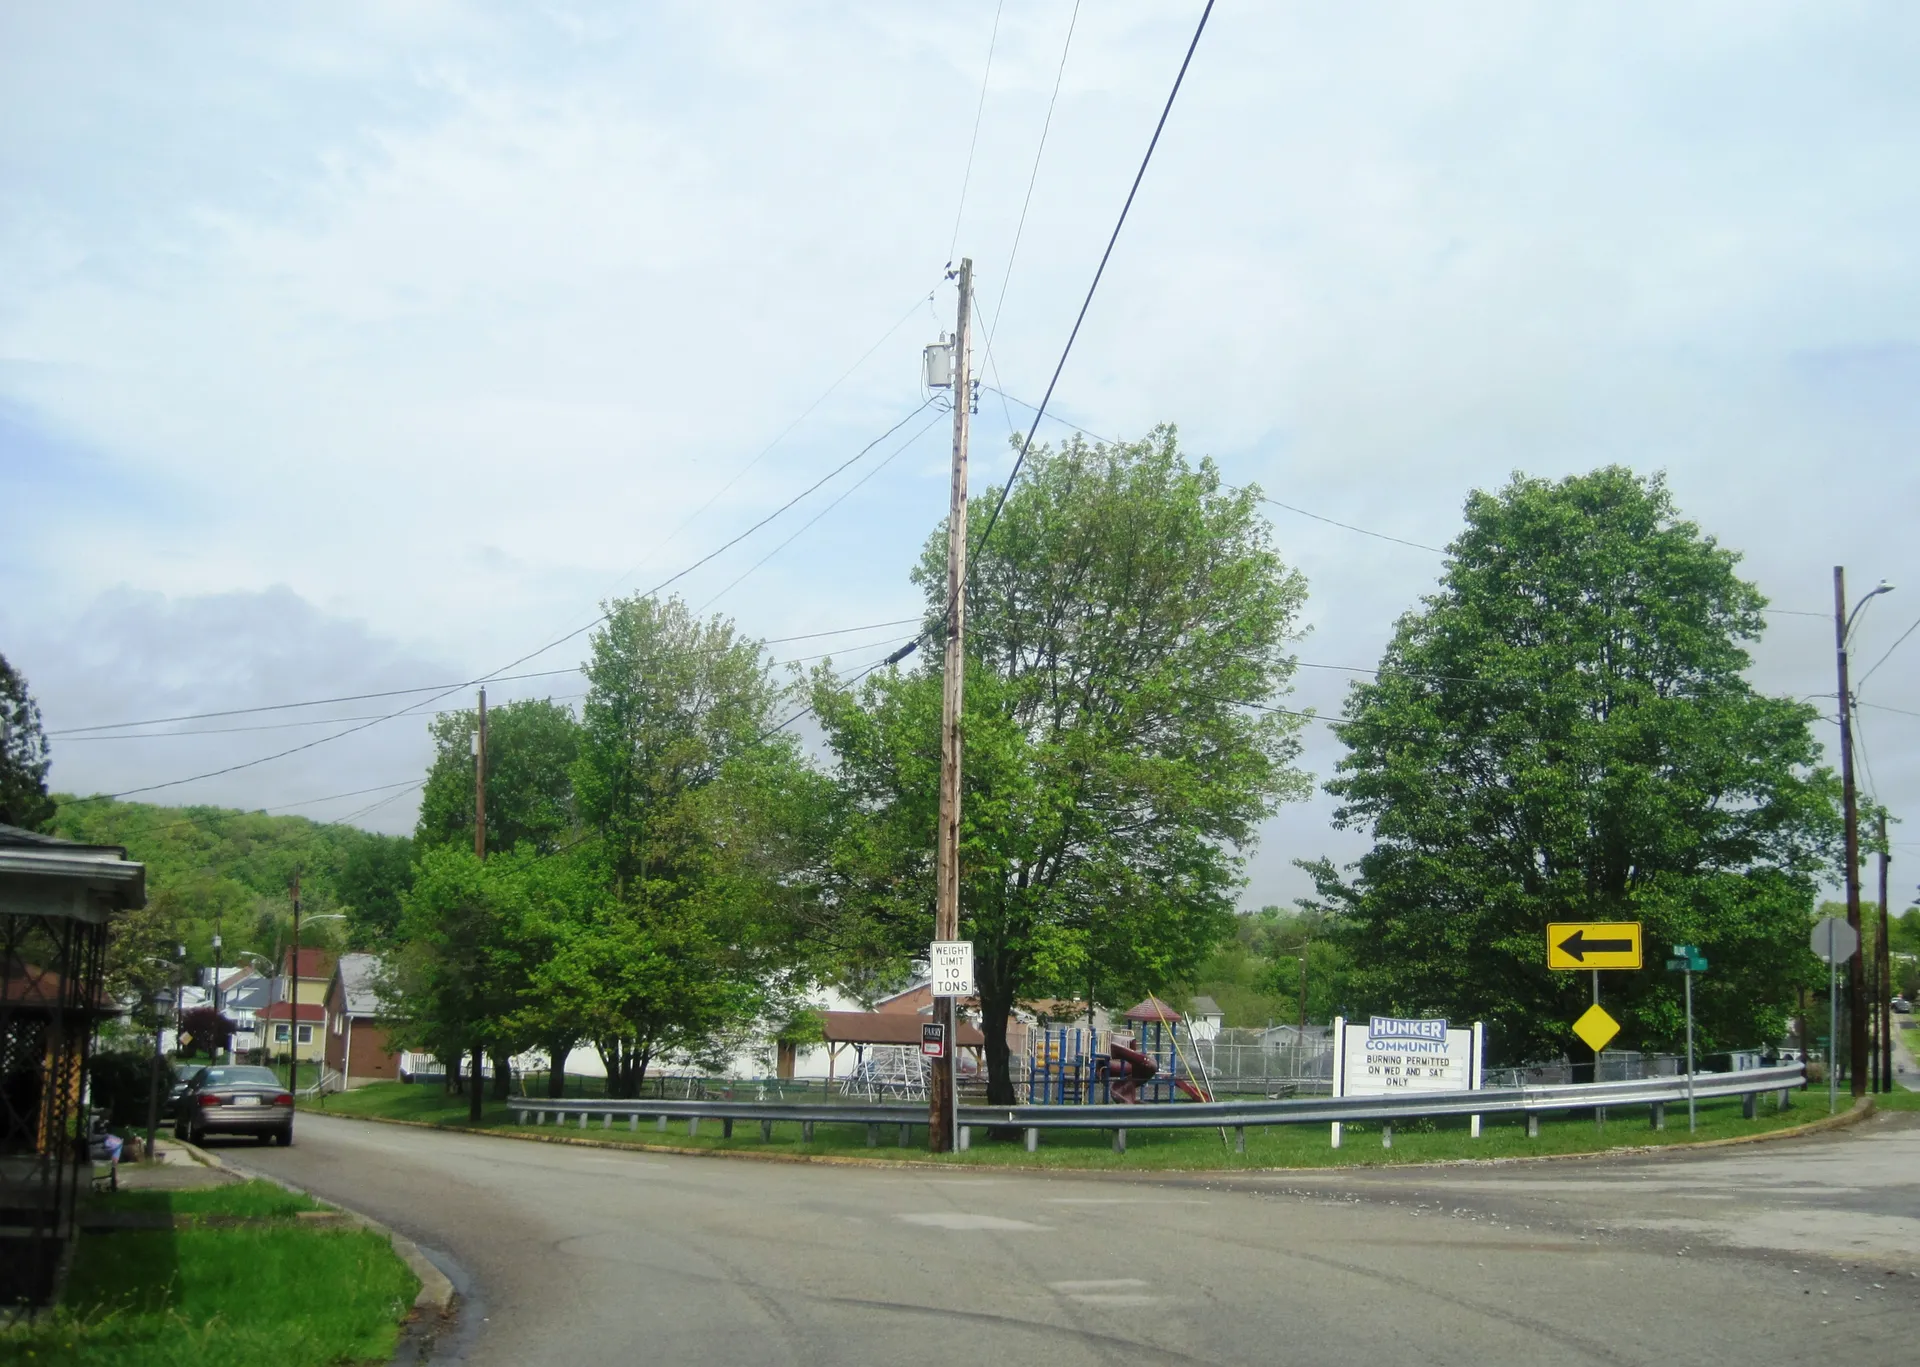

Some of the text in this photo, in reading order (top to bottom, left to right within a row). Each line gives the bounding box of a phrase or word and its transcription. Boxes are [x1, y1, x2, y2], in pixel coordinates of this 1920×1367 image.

[935, 946, 969, 955] WEIGHT
[940, 957, 963, 966] LIMIT
[945, 968, 960, 978] 10
[938, 981, 968, 992] TONS
[1373, 1019, 1442, 1038] HUNKER
[1366, 1040, 1449, 1053] COMMUNITY
[1367, 1055, 1450, 1066] BURNING PERMITTED
[1368, 1066, 1444, 1077] ON WED AND SAT
[1386, 1077, 1409, 1087] ONLY
